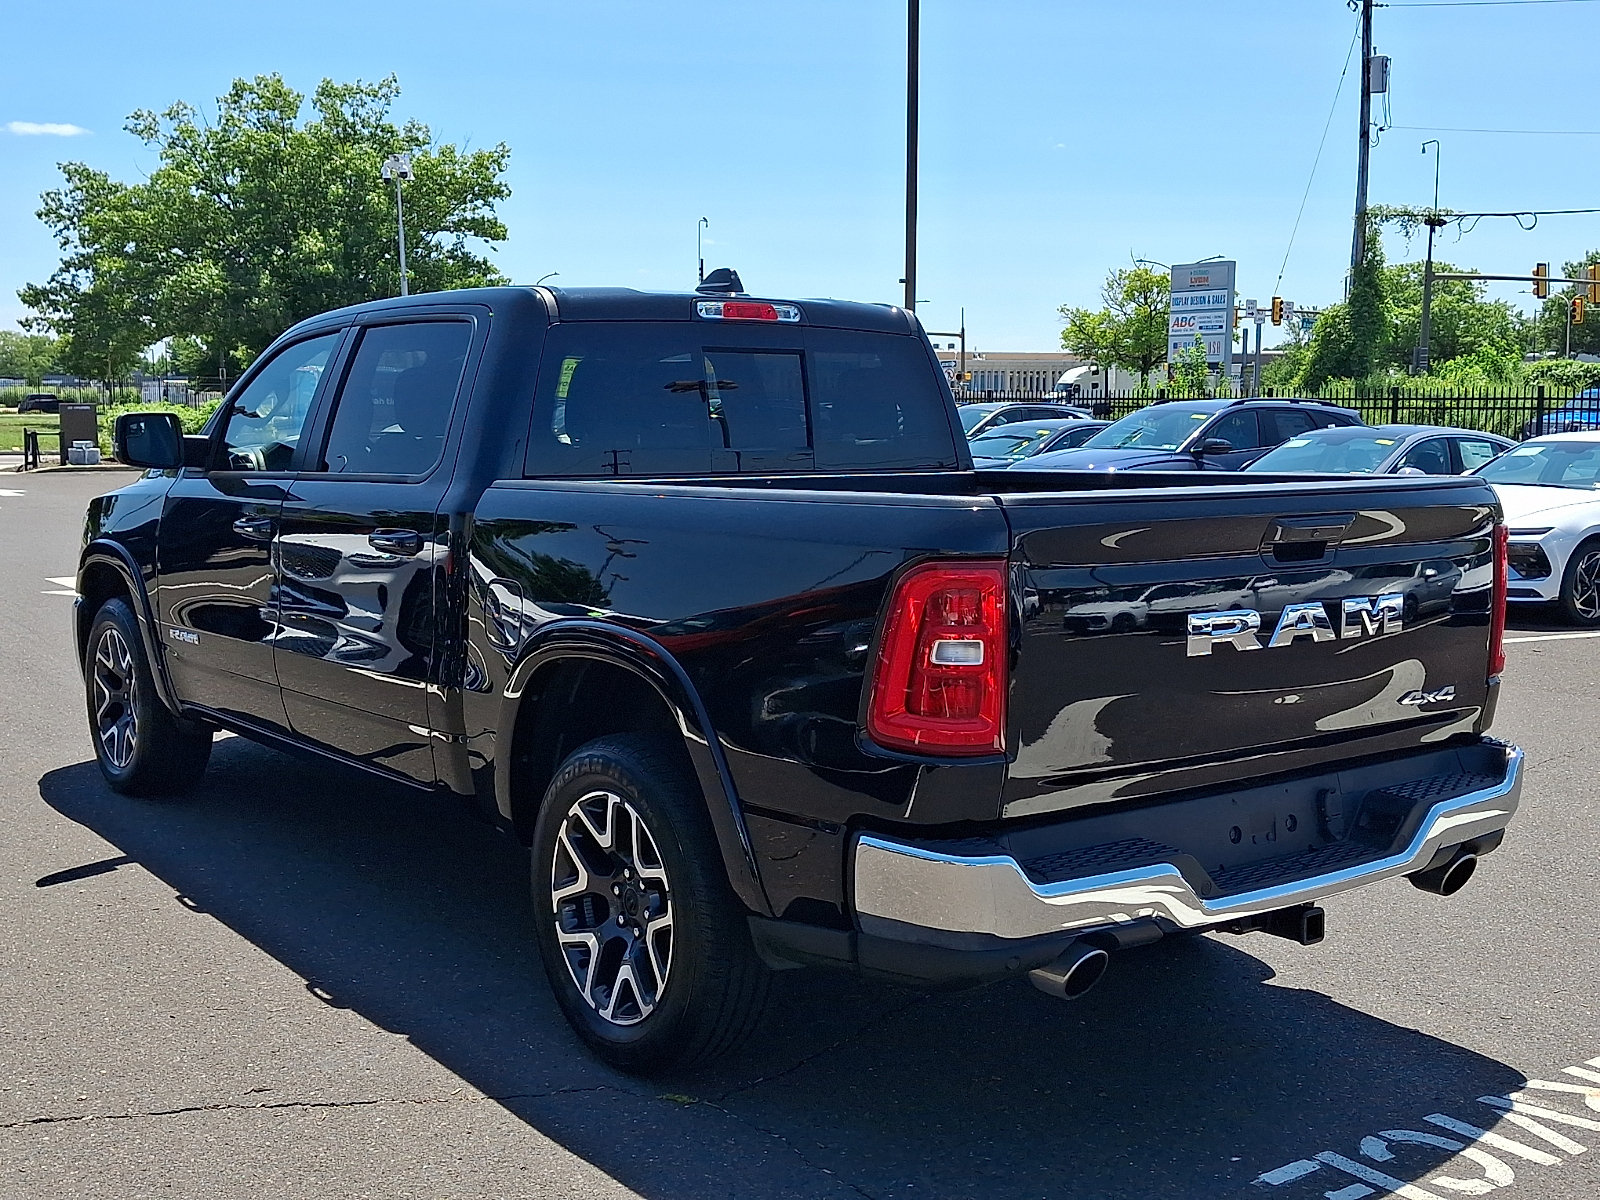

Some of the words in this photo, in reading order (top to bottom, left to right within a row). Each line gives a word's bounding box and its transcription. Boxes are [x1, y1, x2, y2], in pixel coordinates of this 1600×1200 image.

[1172, 296, 1189, 306] DISPLAY
[1190, 295, 1206, 306] DESIGN
[1212, 294, 1226, 304] SALES
[1171, 315, 1196, 328] ABC
[1187, 594, 1403, 656] RAM
[169, 629, 200, 645] RAM
